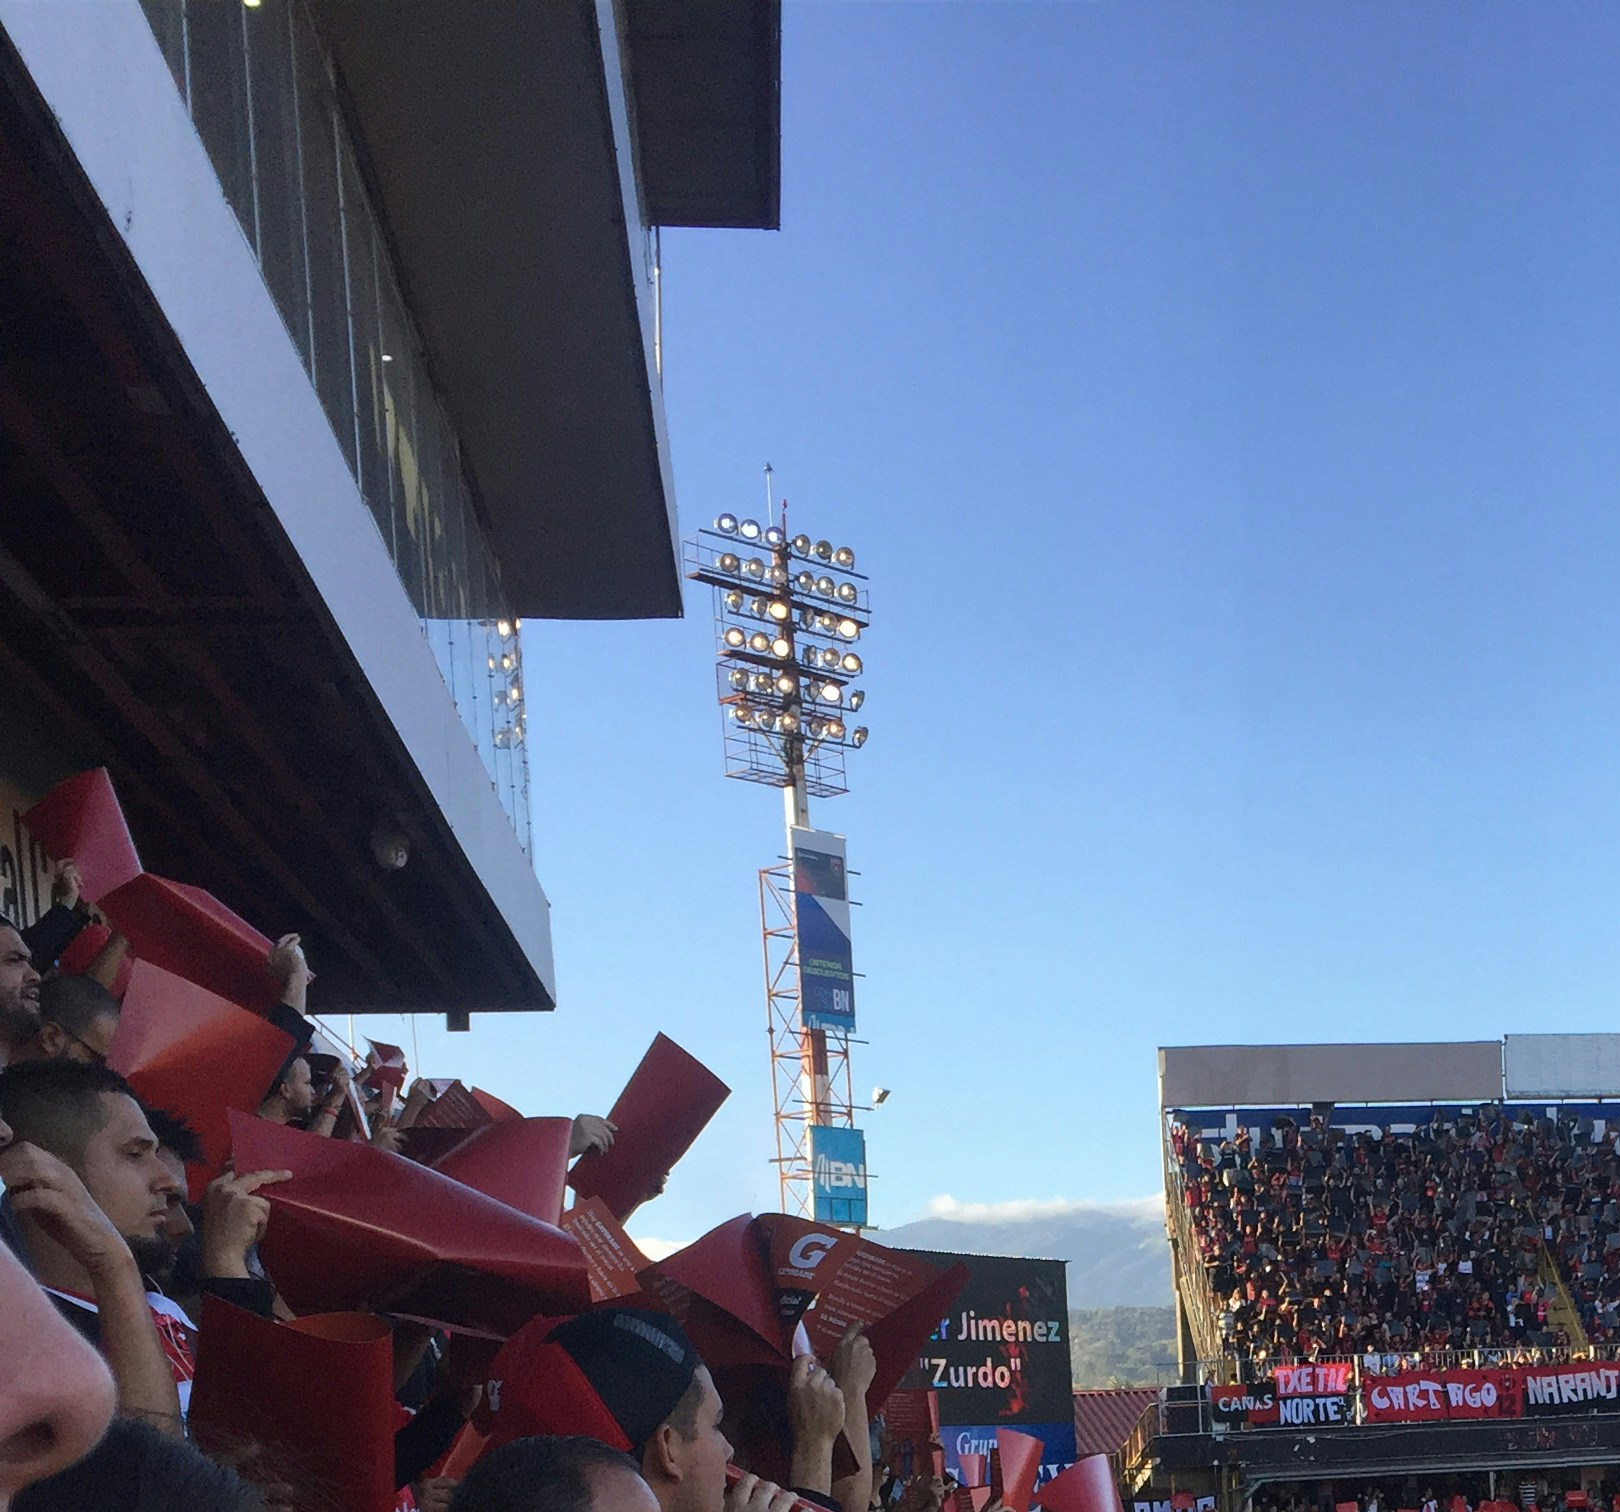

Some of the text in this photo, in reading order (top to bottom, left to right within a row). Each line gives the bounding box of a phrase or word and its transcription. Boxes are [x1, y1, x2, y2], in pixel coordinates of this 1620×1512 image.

[833, 987, 850, 1013] BN
[832, 1161, 866, 1189] BN
[957, 1310, 1061, 1343] Jimenez
[919, 1357, 1021, 1390] "Zurdo"
[1279, 1397, 1342, 1426] NORTE
